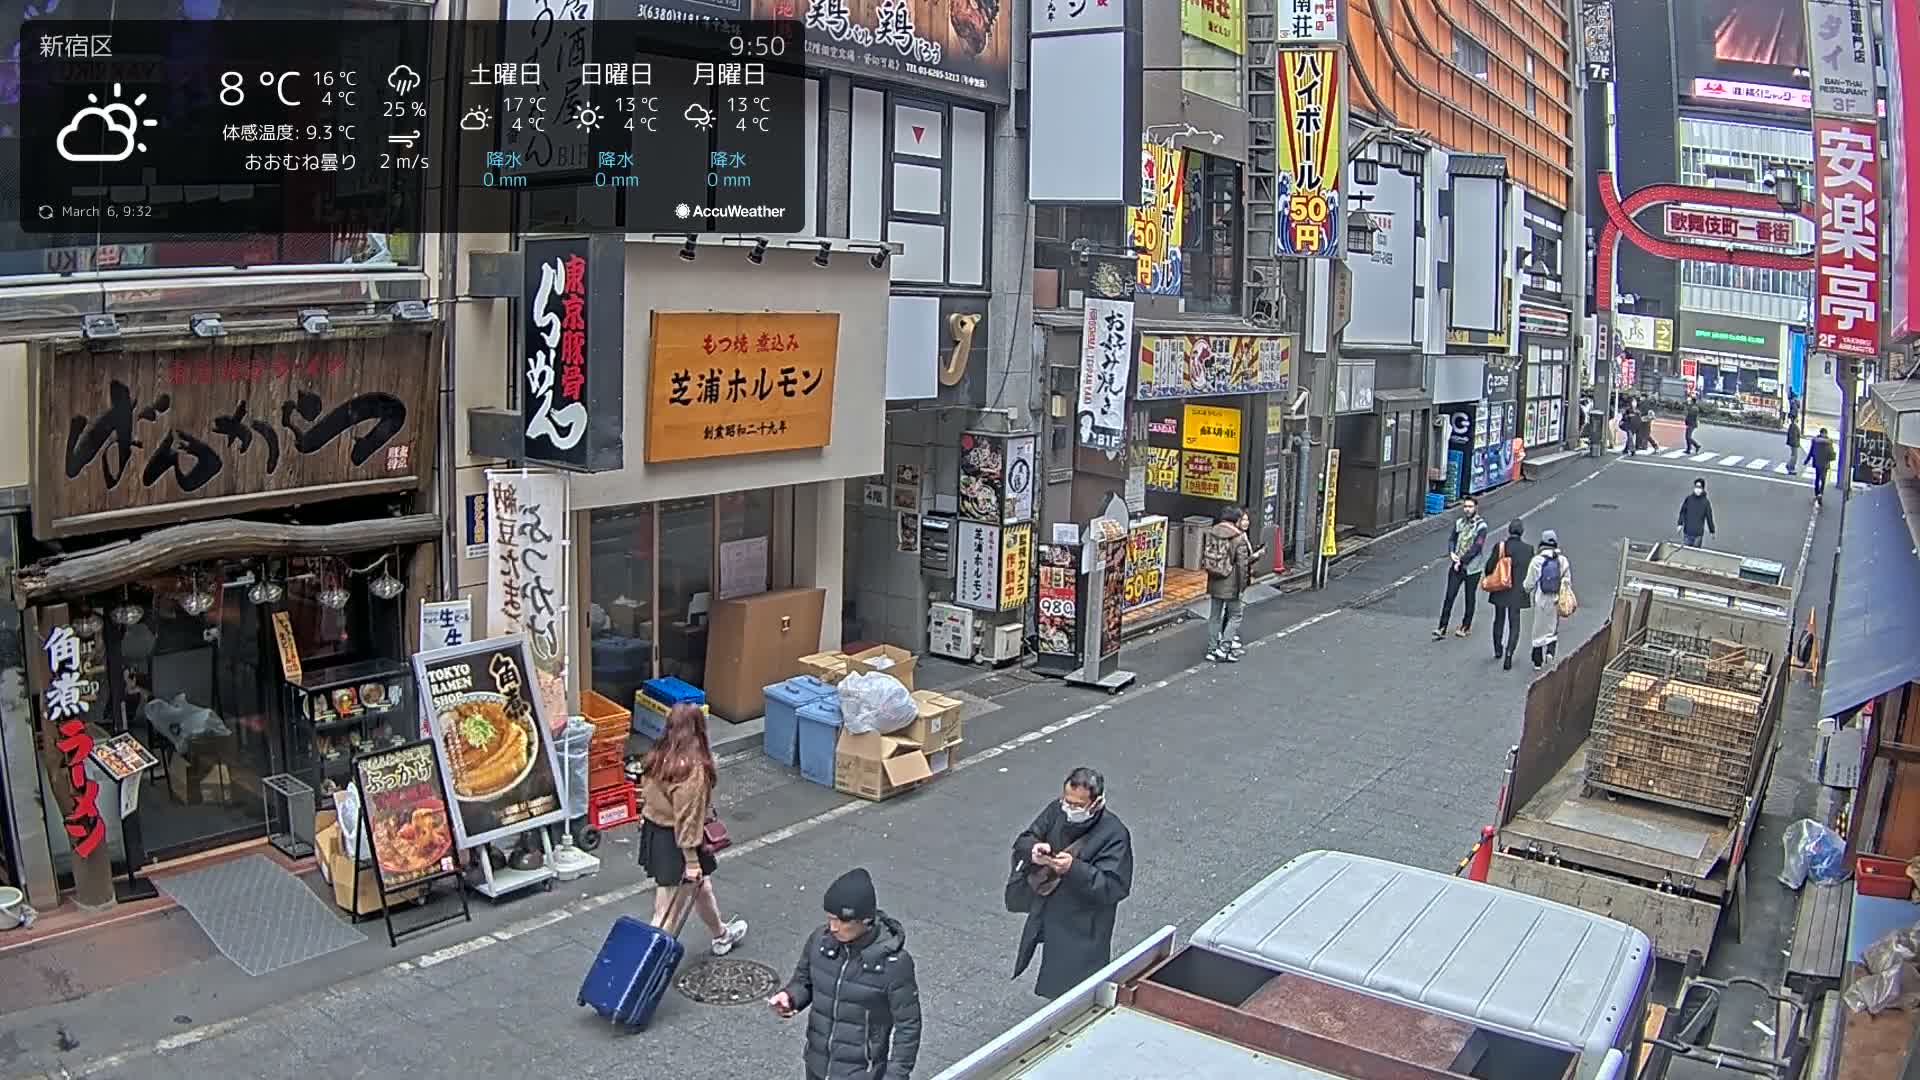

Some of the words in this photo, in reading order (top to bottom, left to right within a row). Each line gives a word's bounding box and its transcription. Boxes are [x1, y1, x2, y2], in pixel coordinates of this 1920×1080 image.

[1590, 64, 1610, 80] 7F
[1832, 97, 1856, 112] 3F
[1295, 54, 1322, 192] ハイボール
[1161, 150, 1176, 288] ハイボール
[1670, 211, 1792, 244] 歌舞伎町一番街
[1819, 127, 1875, 331] 安楽亭
[562, 253, 587, 400] 東京豚骨
[702, 333, 748, 355] もつ焼
[756, 332, 800, 354] 煮込み
[1818, 333, 1837, 348] 2F
[668, 366, 824, 407] 芝浦ホルモン
[703, 421, 788, 441] 創業昭和二十九年
[1097, 433, 1121, 448] B1F
[428, 663, 471, 683] TOKYO
[431, 675, 473, 696] RAMEN
[432, 691, 465, 709] SHOP
